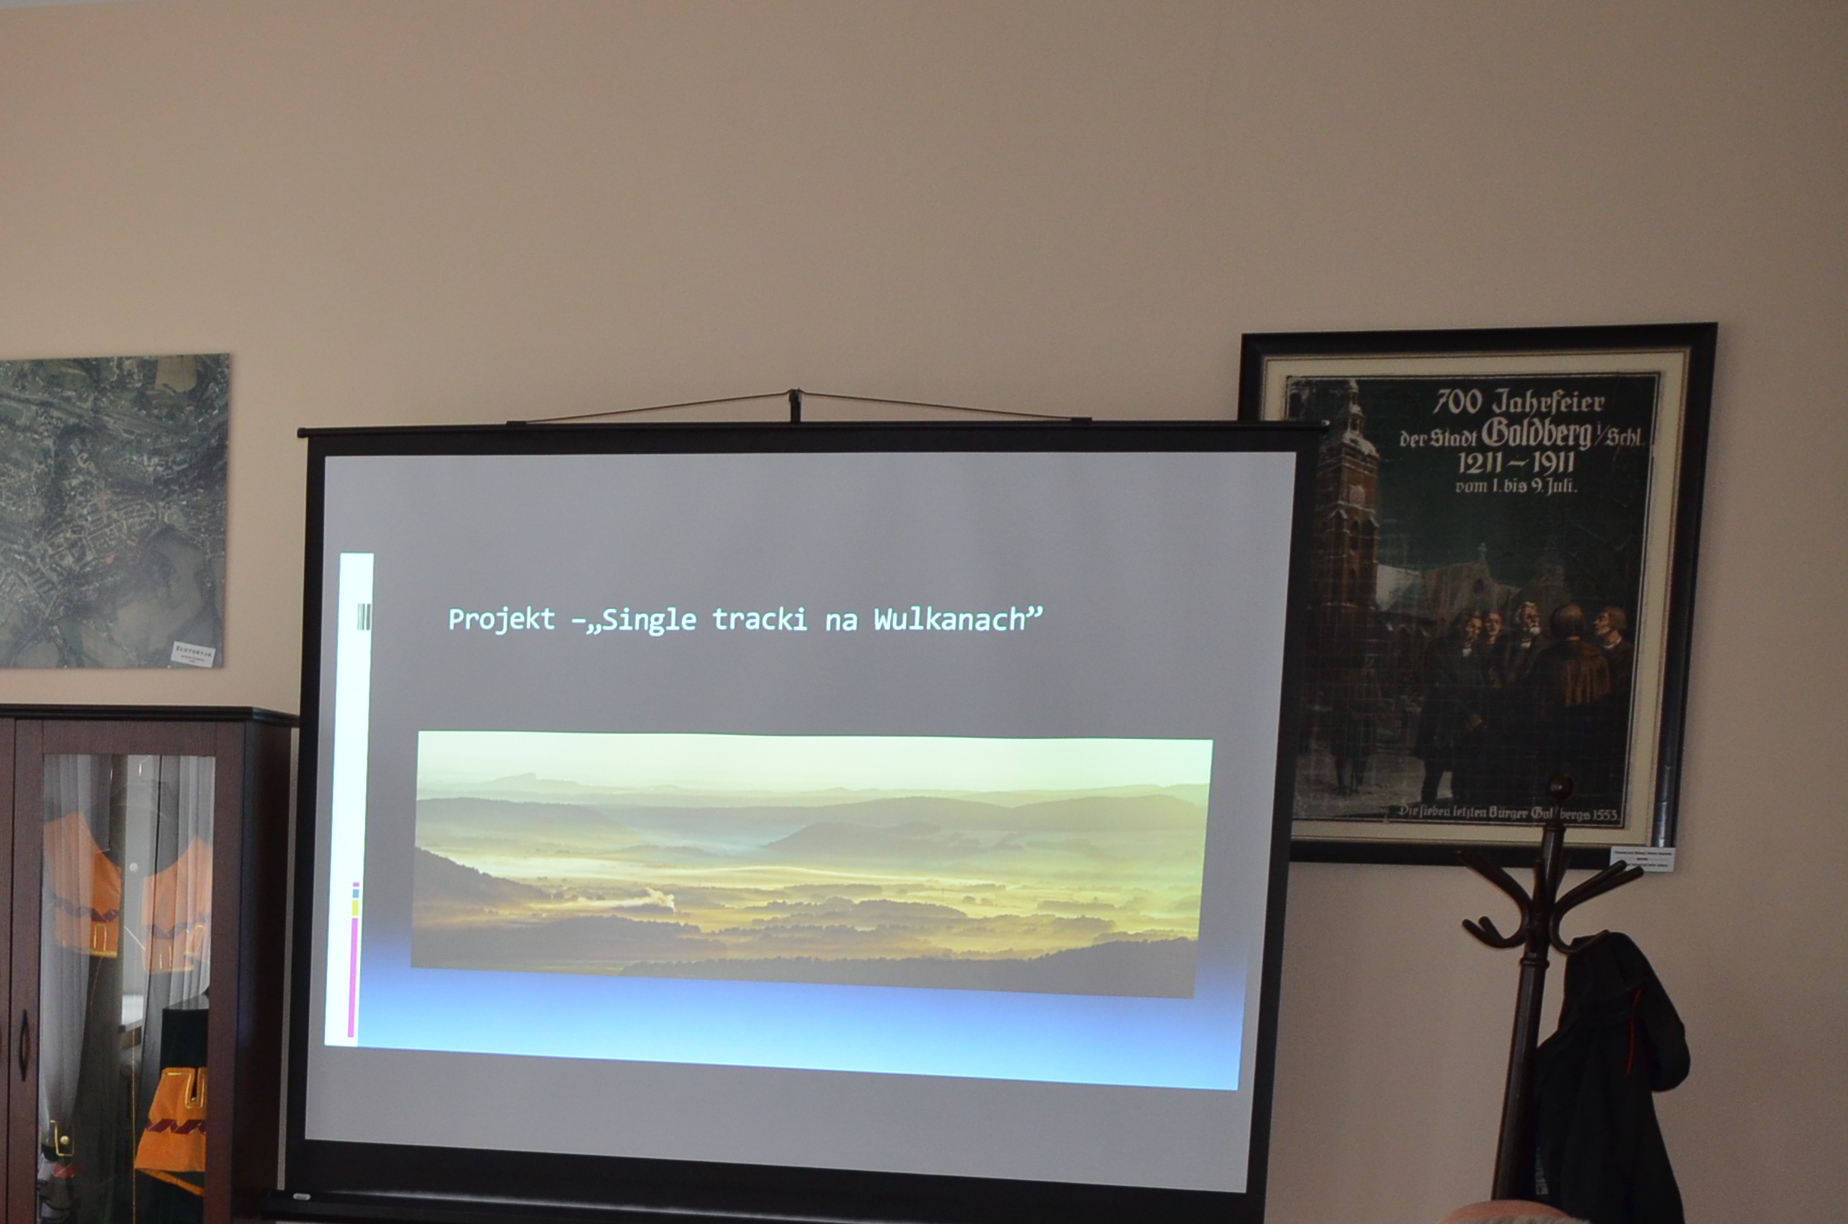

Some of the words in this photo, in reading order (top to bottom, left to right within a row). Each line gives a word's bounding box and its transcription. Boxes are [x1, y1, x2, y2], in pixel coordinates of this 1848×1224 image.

[1432, 388, 1483, 414] 700
[1492, 388, 1606, 416] Jahrfeier
[1400, 430, 1428, 449] der
[1430, 429, 1477, 448] Stadt
[1482, 416, 1592, 451] Goldberg
[1455, 481, 1488, 493] vom
[449, 605, 556, 636] Projekt
[712, 606, 808, 632] tracki
[825, 610, 859, 632] na
[1530, 805, 1591, 822] Golbergs
